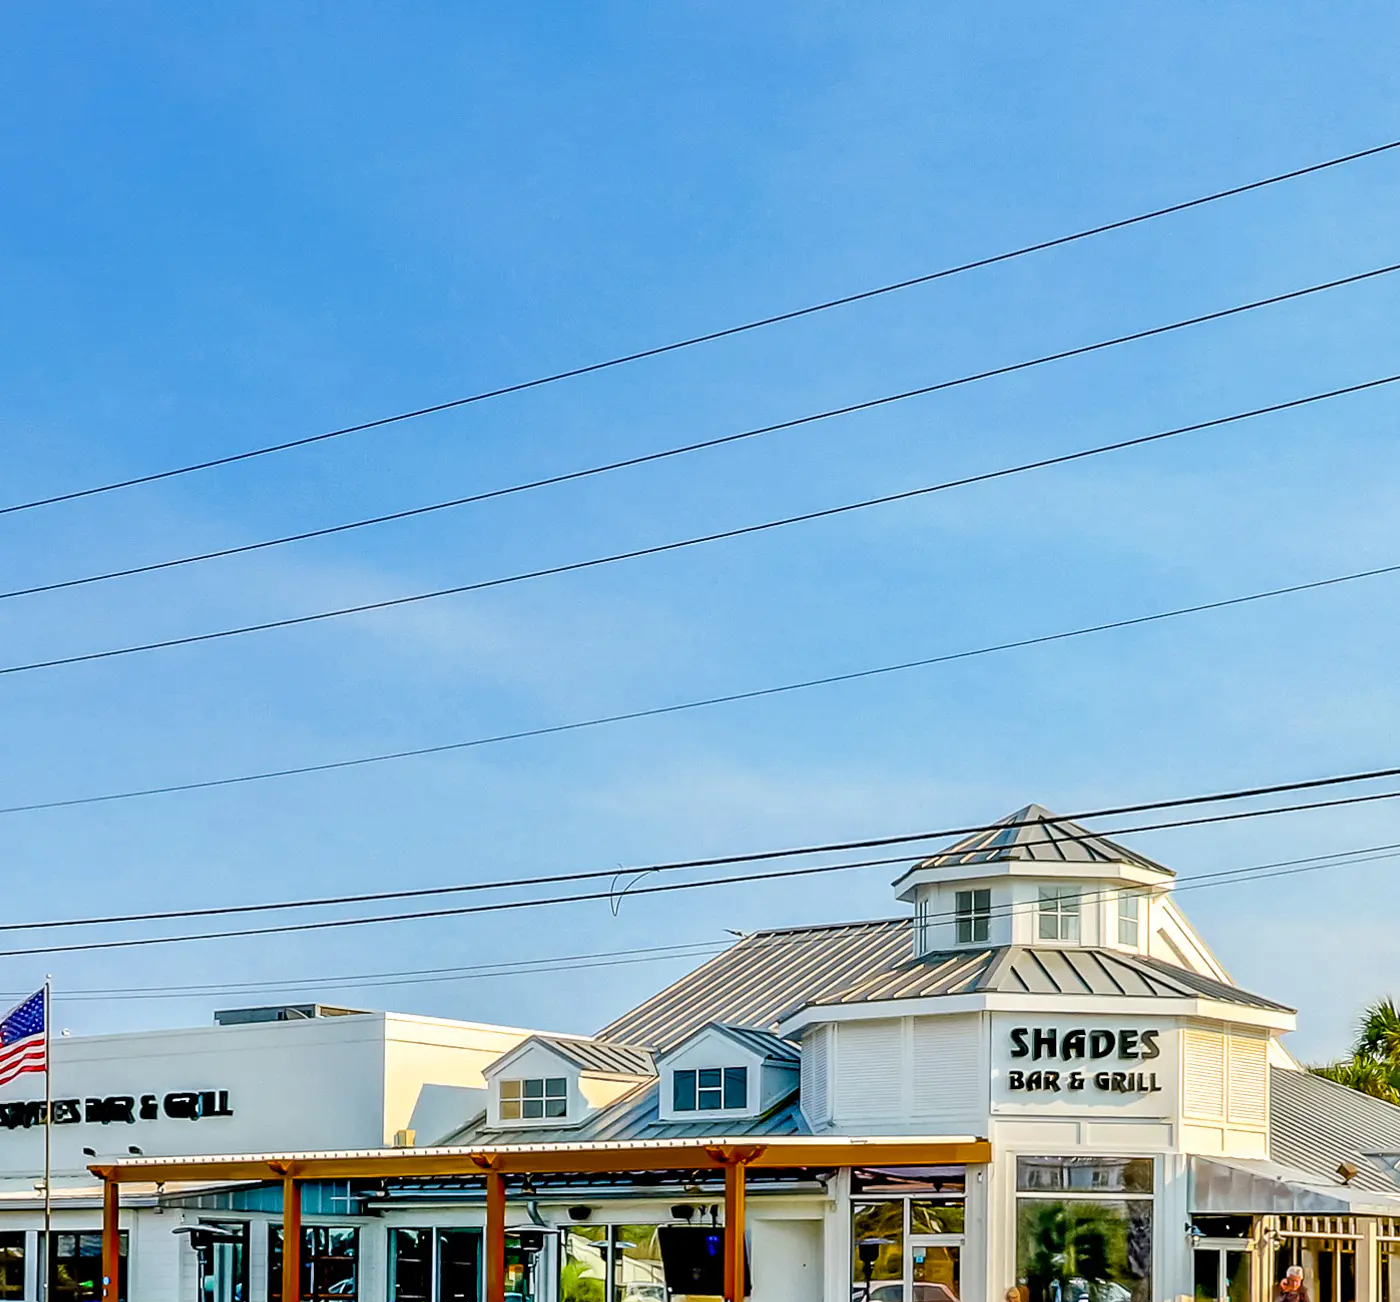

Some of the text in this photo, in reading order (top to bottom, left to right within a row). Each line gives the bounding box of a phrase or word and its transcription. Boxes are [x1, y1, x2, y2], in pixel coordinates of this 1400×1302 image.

[1010, 1027, 1160, 1061] SHADES
[1009, 1070, 1162, 1094] BAR & GRILL
[140, 1094, 158, 1120] &
[164, 1090, 234, 1121] GRILL
